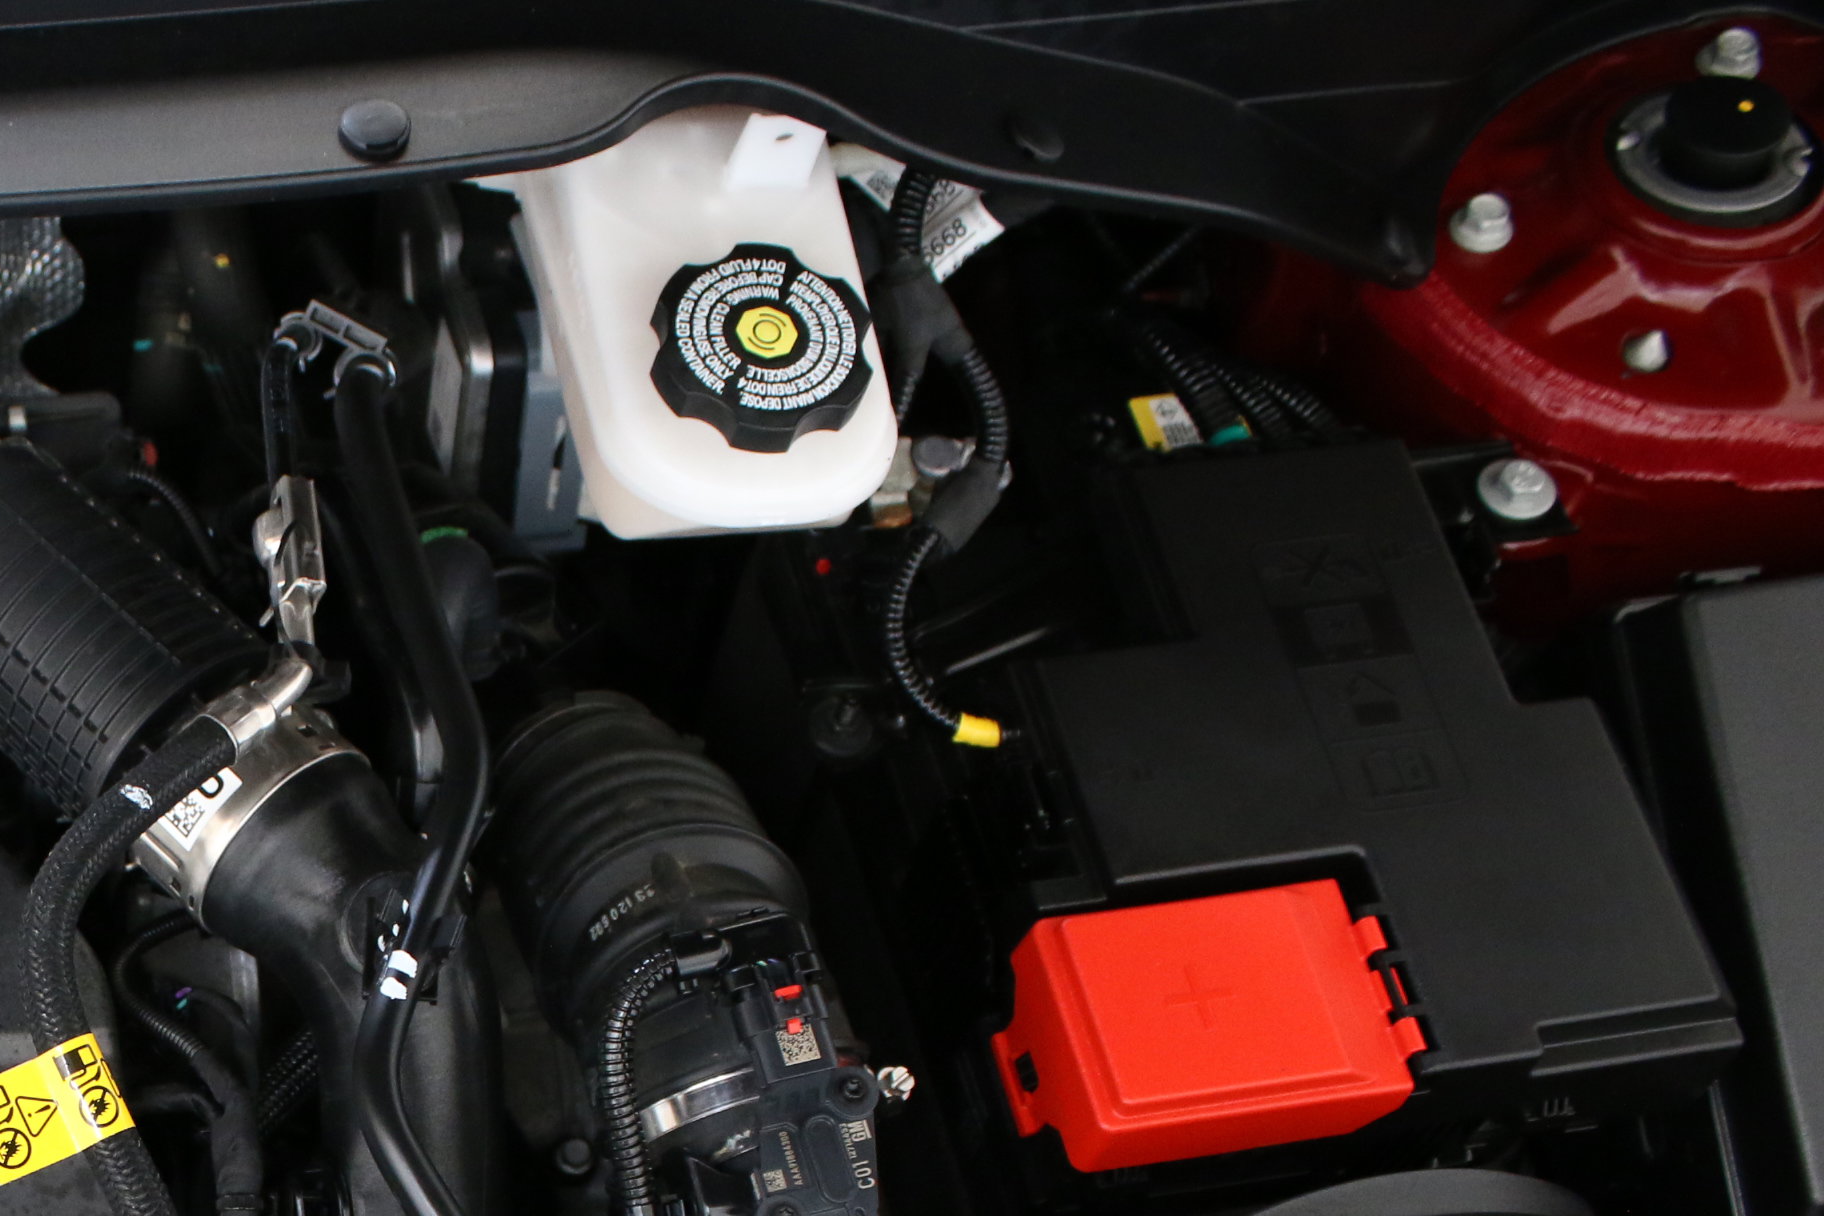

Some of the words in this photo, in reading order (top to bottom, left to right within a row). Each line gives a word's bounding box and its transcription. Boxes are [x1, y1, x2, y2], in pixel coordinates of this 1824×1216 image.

[718, 259, 751, 275] FLUID
[760, 259, 787, 272] DOT
[690, 269, 721, 293] FROM
[713, 272, 759, 291] BEFORE
[758, 273, 783, 286] CAP
[675, 297, 694, 337] SEALED
[709, 302, 730, 336] CLEAN
[694, 335, 714, 357] USE
[710, 335, 742, 369] FILLER
[704, 355, 734, 380] ONLY
[746, 383, 767, 395] DOT
[767, 380, 799, 396] FREIN
[811, 365, 852, 400] BOUCHON
[782, 389, 817, 410] AVANT
[848, 1119, 869, 1143] GM
